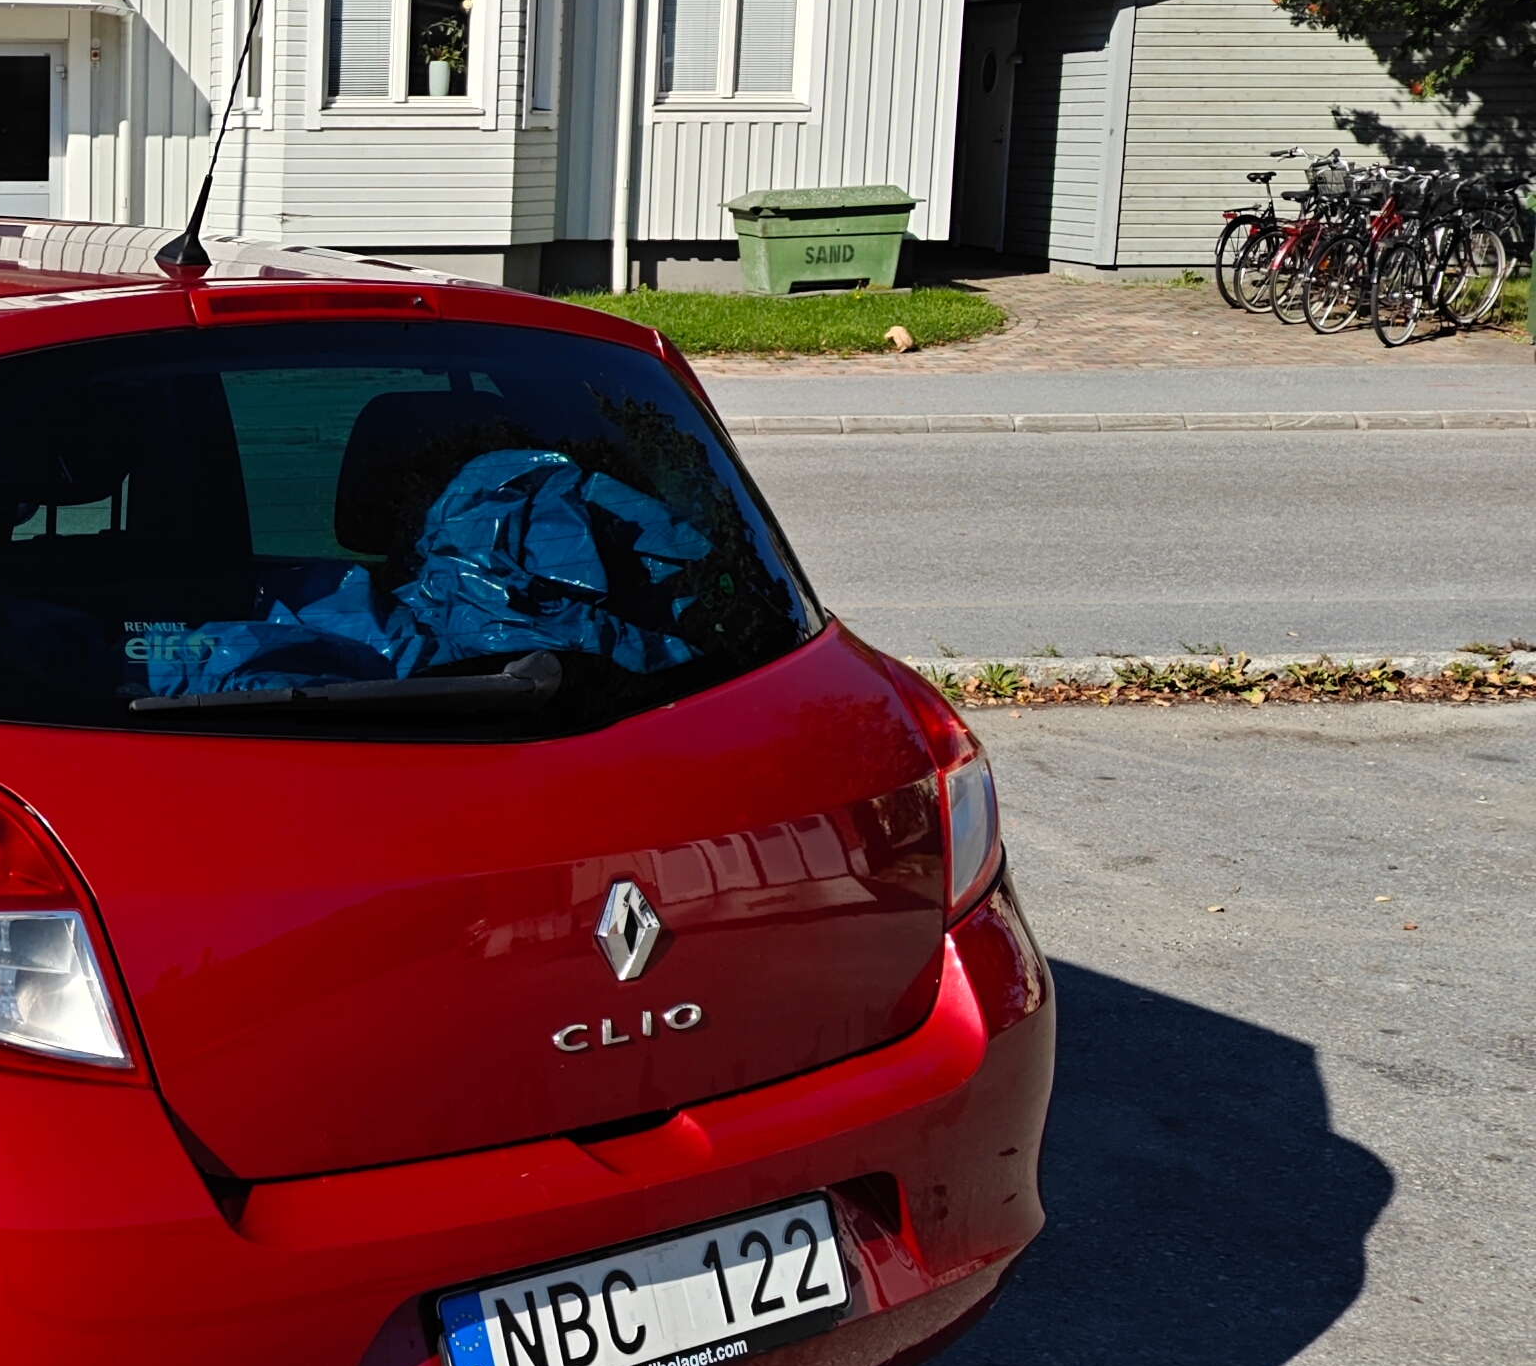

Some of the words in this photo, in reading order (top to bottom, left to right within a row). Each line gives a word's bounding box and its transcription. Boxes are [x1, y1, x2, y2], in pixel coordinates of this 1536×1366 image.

[804, 243, 855, 265] SAND
[124, 621, 187, 632] RENAULT
[125, 636, 181, 660] elf
[552, 1002, 703, 1052] CLIO
[701, 1218, 831, 1325] 122
